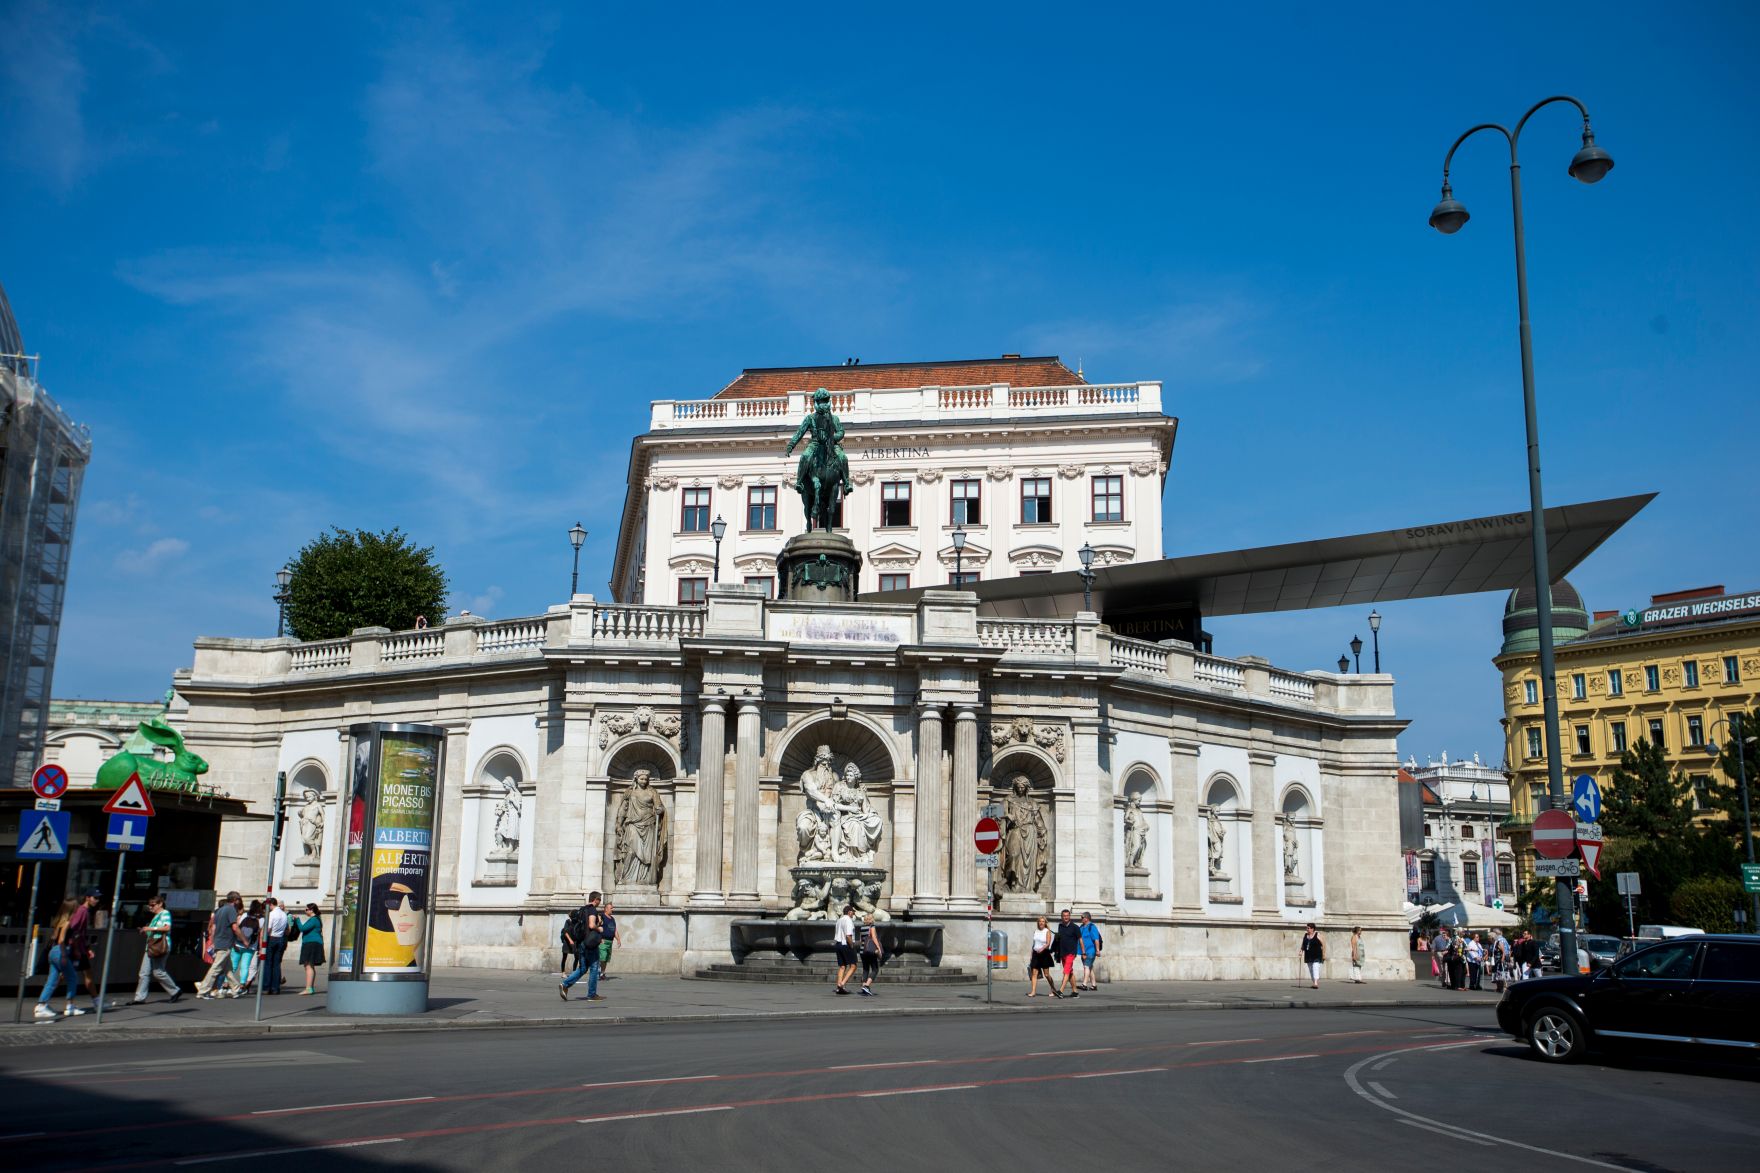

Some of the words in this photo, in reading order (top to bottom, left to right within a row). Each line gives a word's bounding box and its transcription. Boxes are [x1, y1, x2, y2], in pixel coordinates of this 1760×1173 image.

[862, 447, 930, 460] ALBERTINA
[1406, 521, 1473, 539] SORAVIA
[1479, 513, 1527, 529] WING
[1644, 606, 1689, 622] GRAZER
[1111, 619, 1184, 635] ALBERTINA
[843, 631, 871, 641] WIEN
[383, 783, 420, 796] MONET
[420, 785, 432, 798] BIS
[382, 795, 424, 809] PICASSO
[375, 866, 424, 877] contemporary
[1536, 864, 1558, 873] ausgen.
